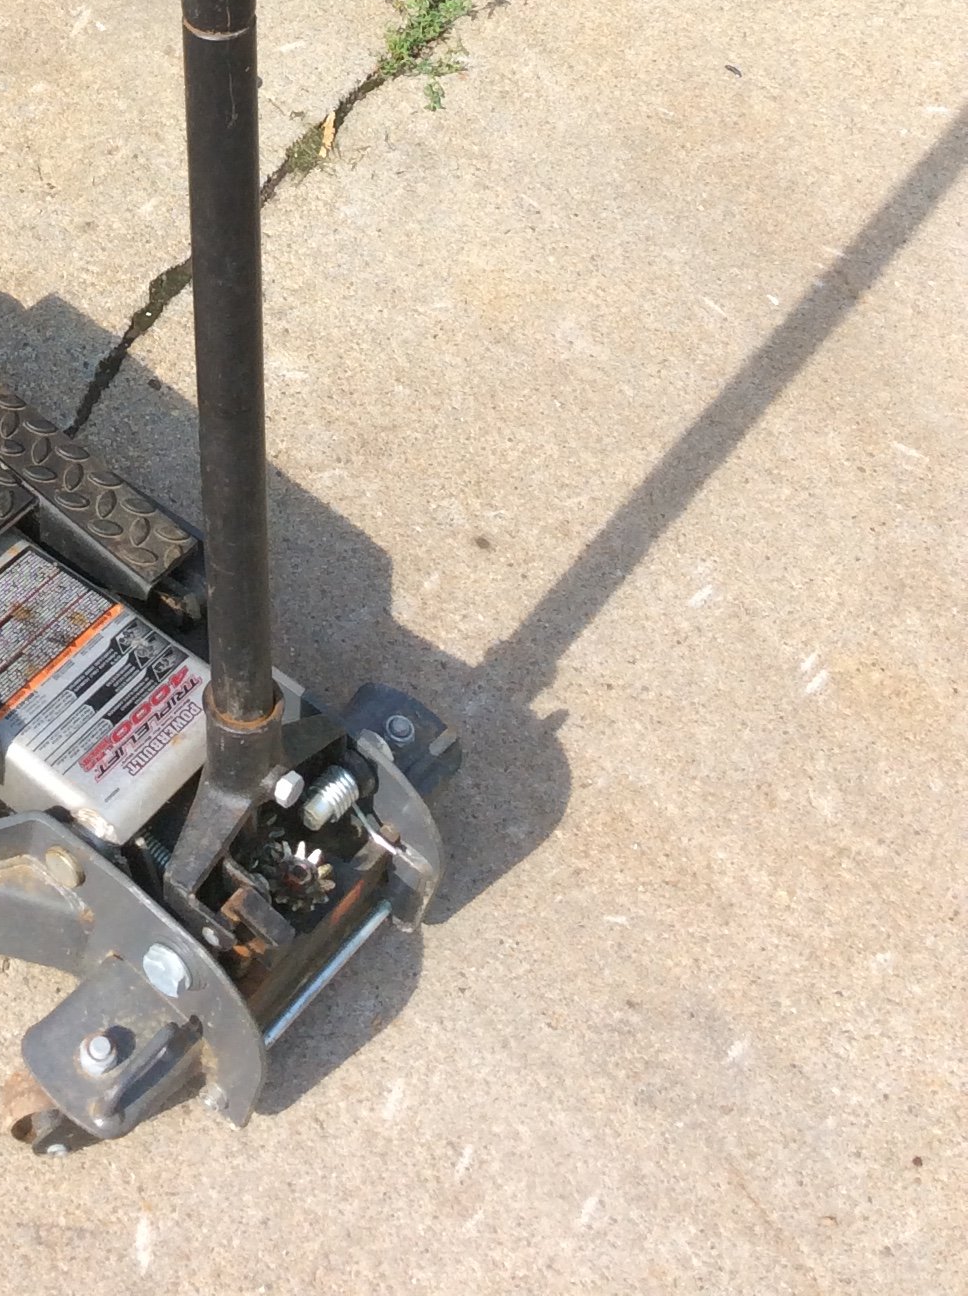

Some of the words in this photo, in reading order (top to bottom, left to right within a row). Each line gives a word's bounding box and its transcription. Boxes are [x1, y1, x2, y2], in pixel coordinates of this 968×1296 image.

[94, 675, 203, 783] TRIPLELIFT
[109, 665, 190, 743] 4000
[123, 701, 203, 777] POWERBUILT
